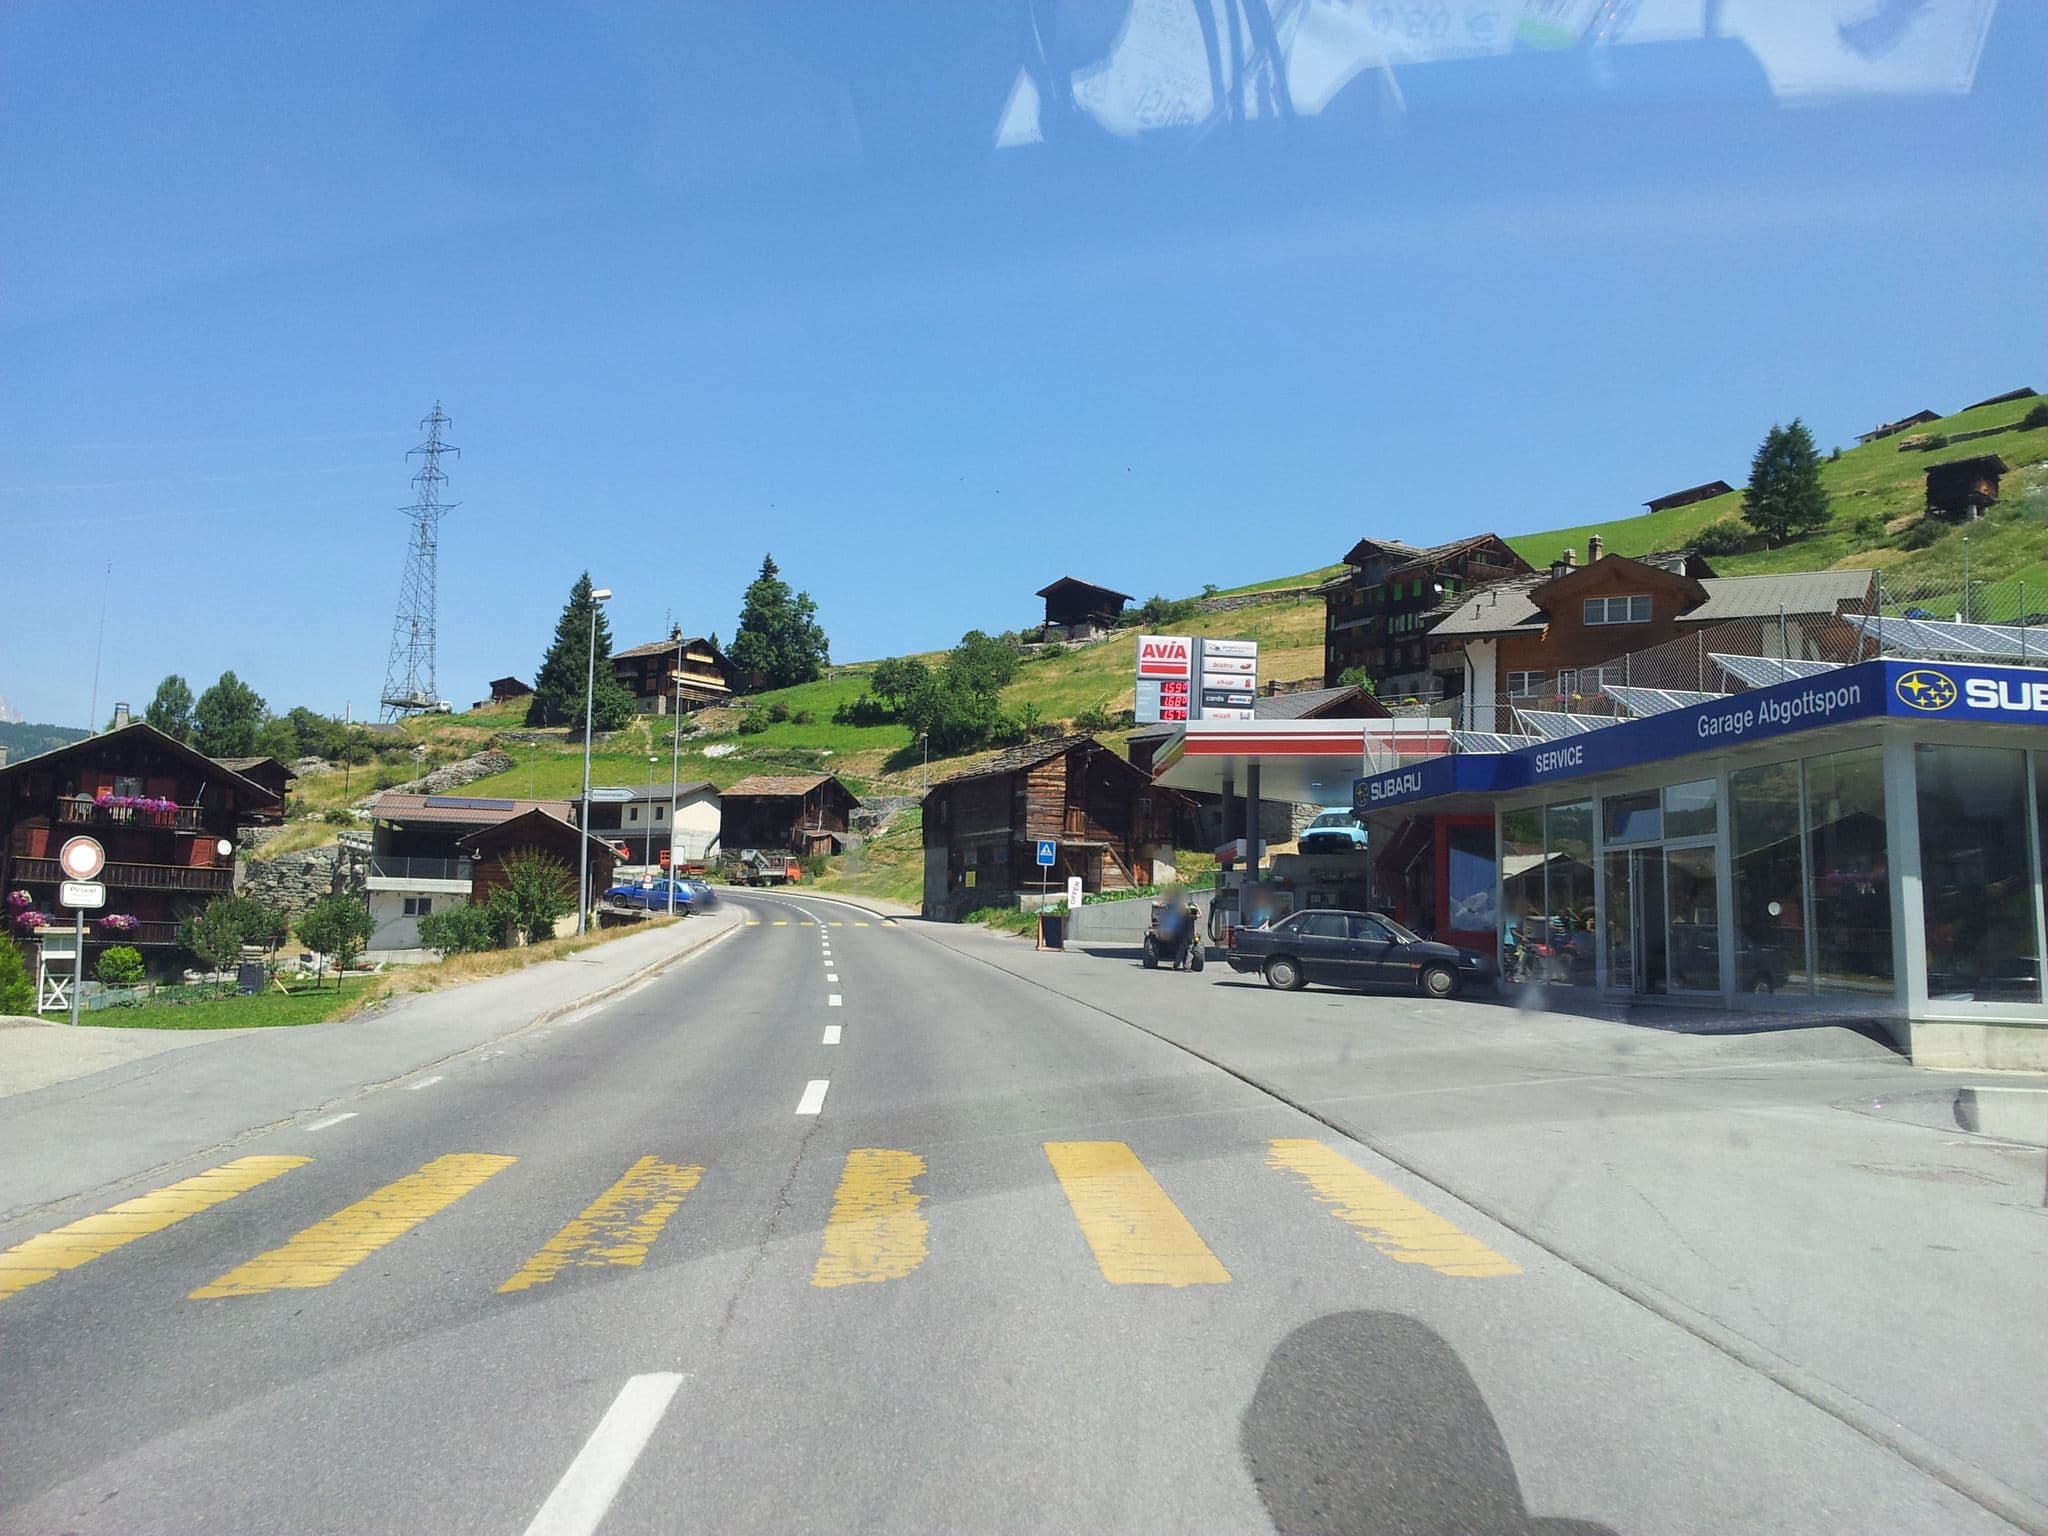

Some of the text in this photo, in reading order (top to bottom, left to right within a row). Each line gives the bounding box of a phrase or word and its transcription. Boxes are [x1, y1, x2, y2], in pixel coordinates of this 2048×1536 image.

[1142, 641, 1188, 659] AVIA
[1697, 684, 1861, 738] Garage Abgottspon
[1536, 745, 1583, 773] SERVICE
[1371, 772, 1422, 801] SUBARU
